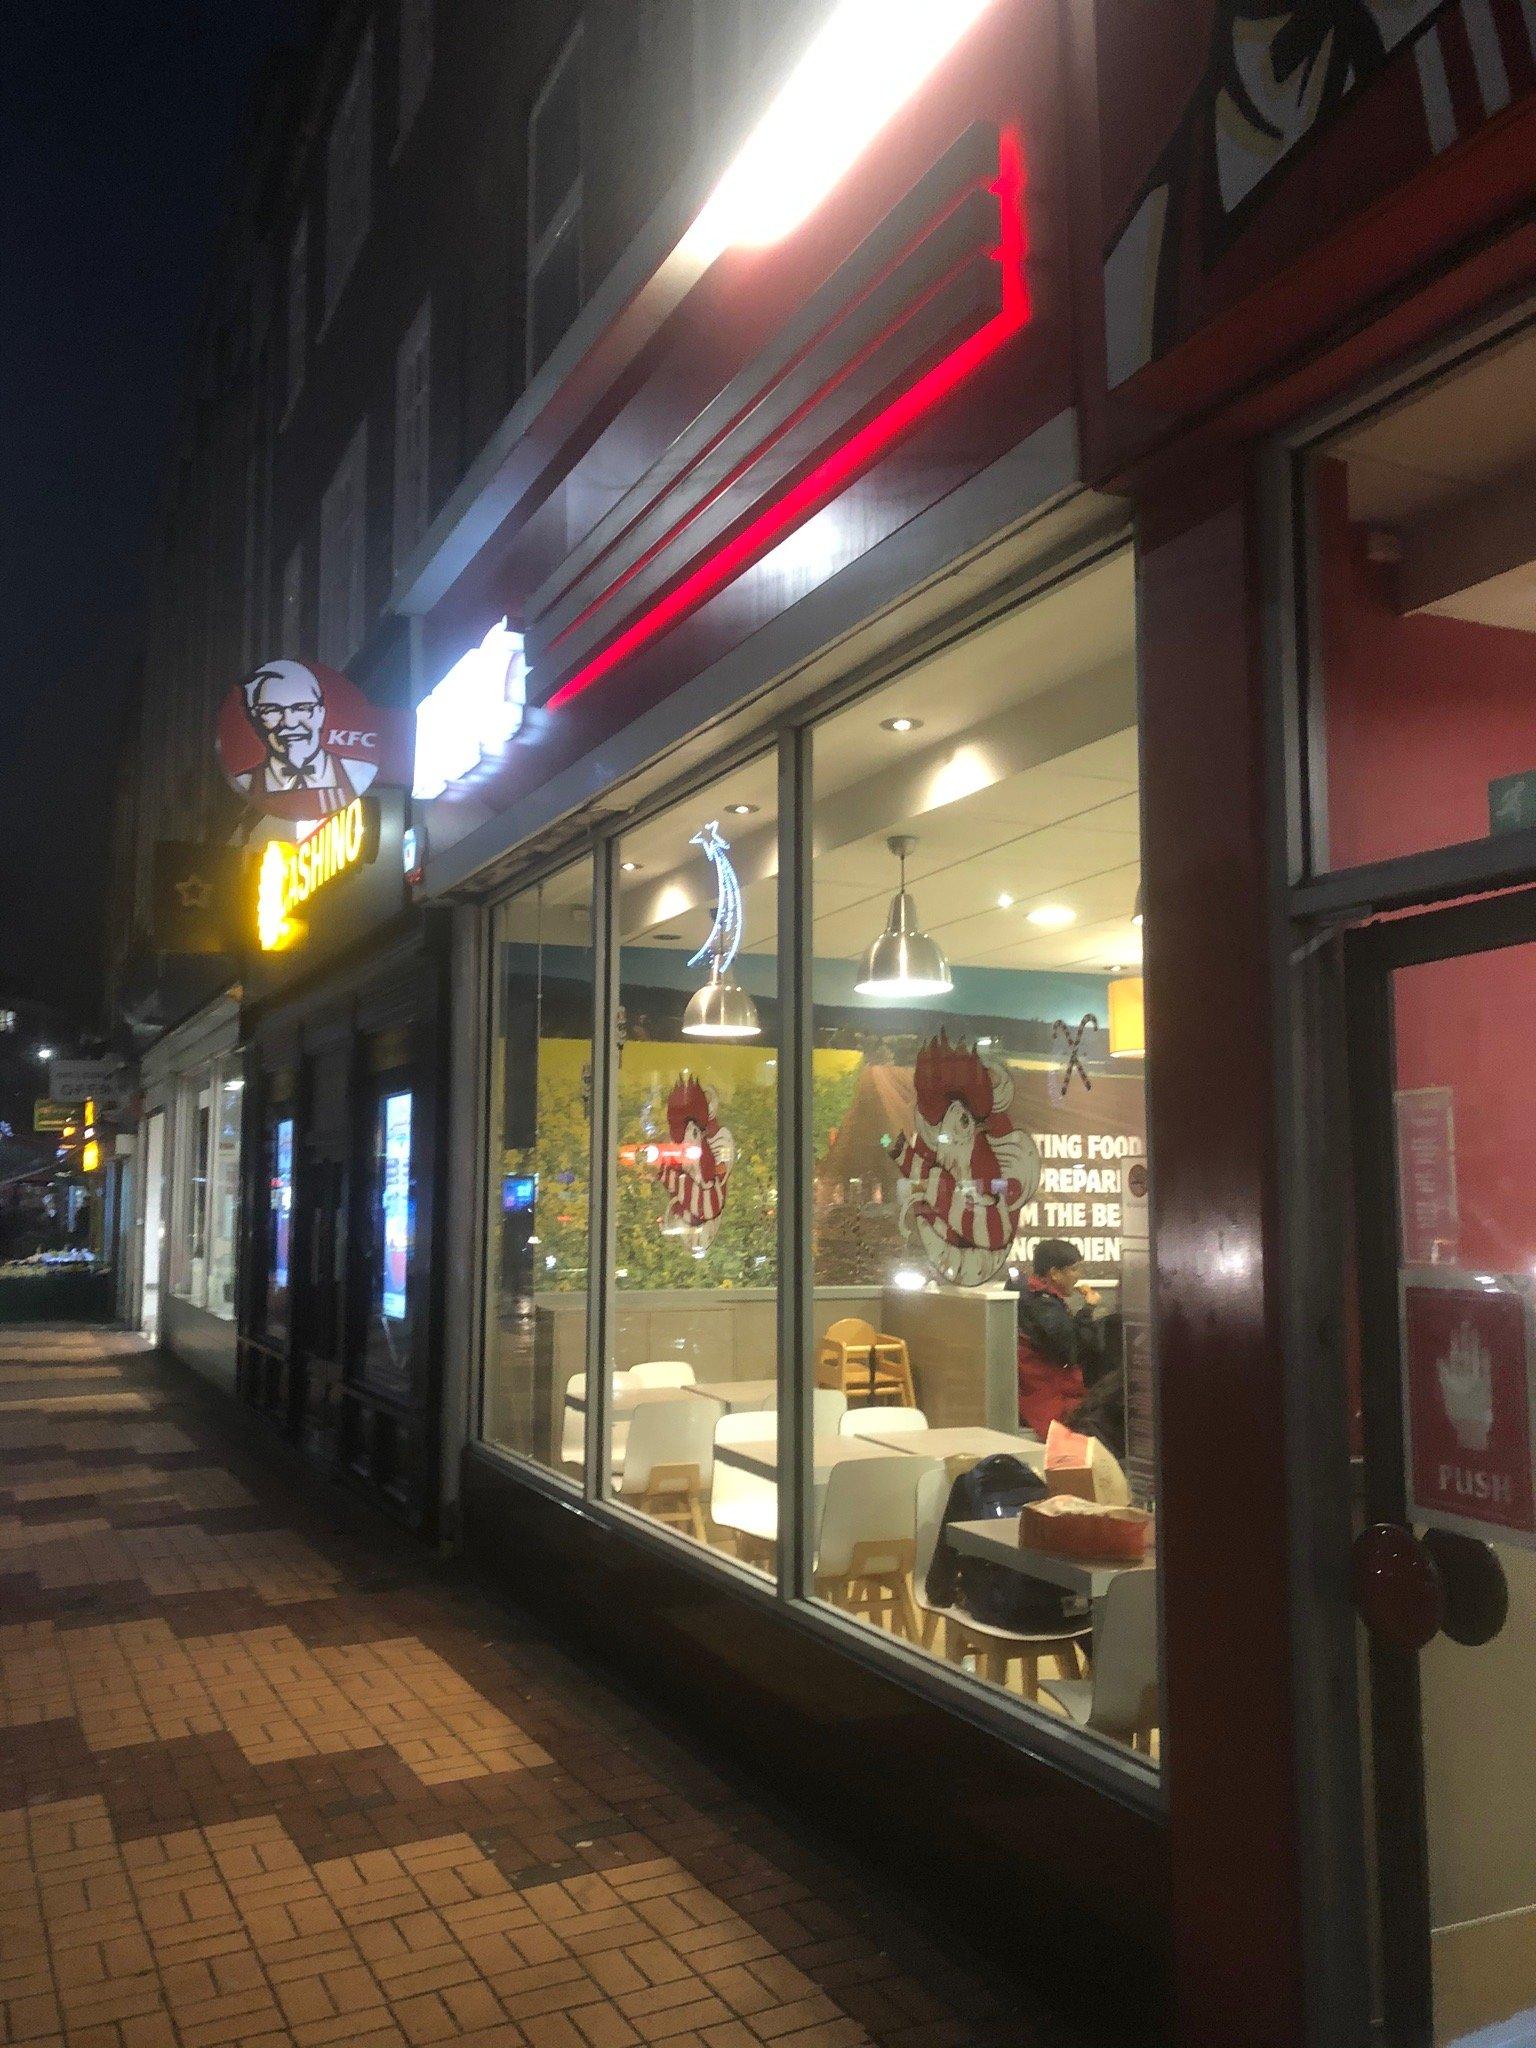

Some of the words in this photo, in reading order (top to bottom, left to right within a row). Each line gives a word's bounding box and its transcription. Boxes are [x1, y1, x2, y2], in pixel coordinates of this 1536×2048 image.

[327, 730, 379, 748] KFC
[1088, 1135, 1142, 1160] FOOD
[1044, 1202, 1086, 1228] THE
[1092, 1202, 1121, 1228] BE
[1438, 1464, 1511, 1503] PUSH
